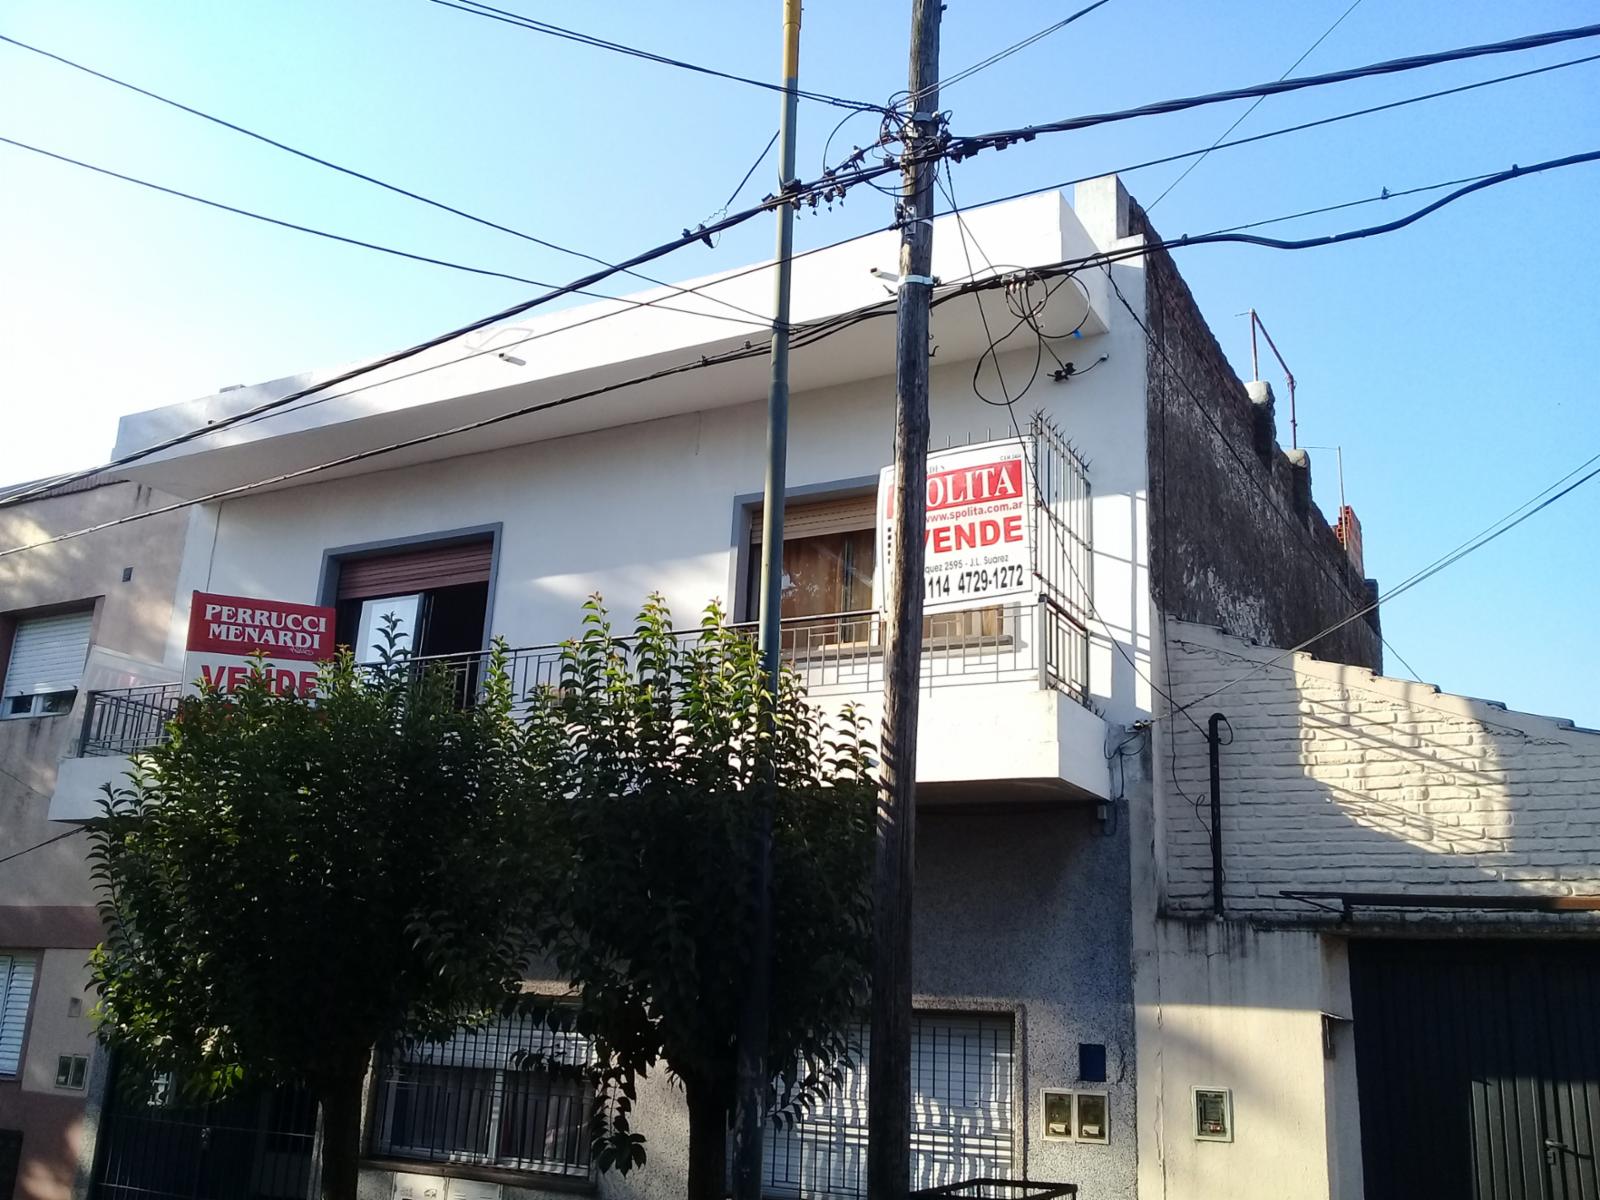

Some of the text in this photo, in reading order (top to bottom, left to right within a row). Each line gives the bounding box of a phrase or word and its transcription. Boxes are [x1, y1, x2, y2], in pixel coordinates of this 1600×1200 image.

[926, 466, 1016, 506] OLITA
[925, 563, 942, 574] quez
[945, 560, 963, 571] 2595
[958, 564, 1024, 594] 4729-1272
[204, 604, 327, 633] PERRUCCI
[208, 623, 321, 649] MENARDI
